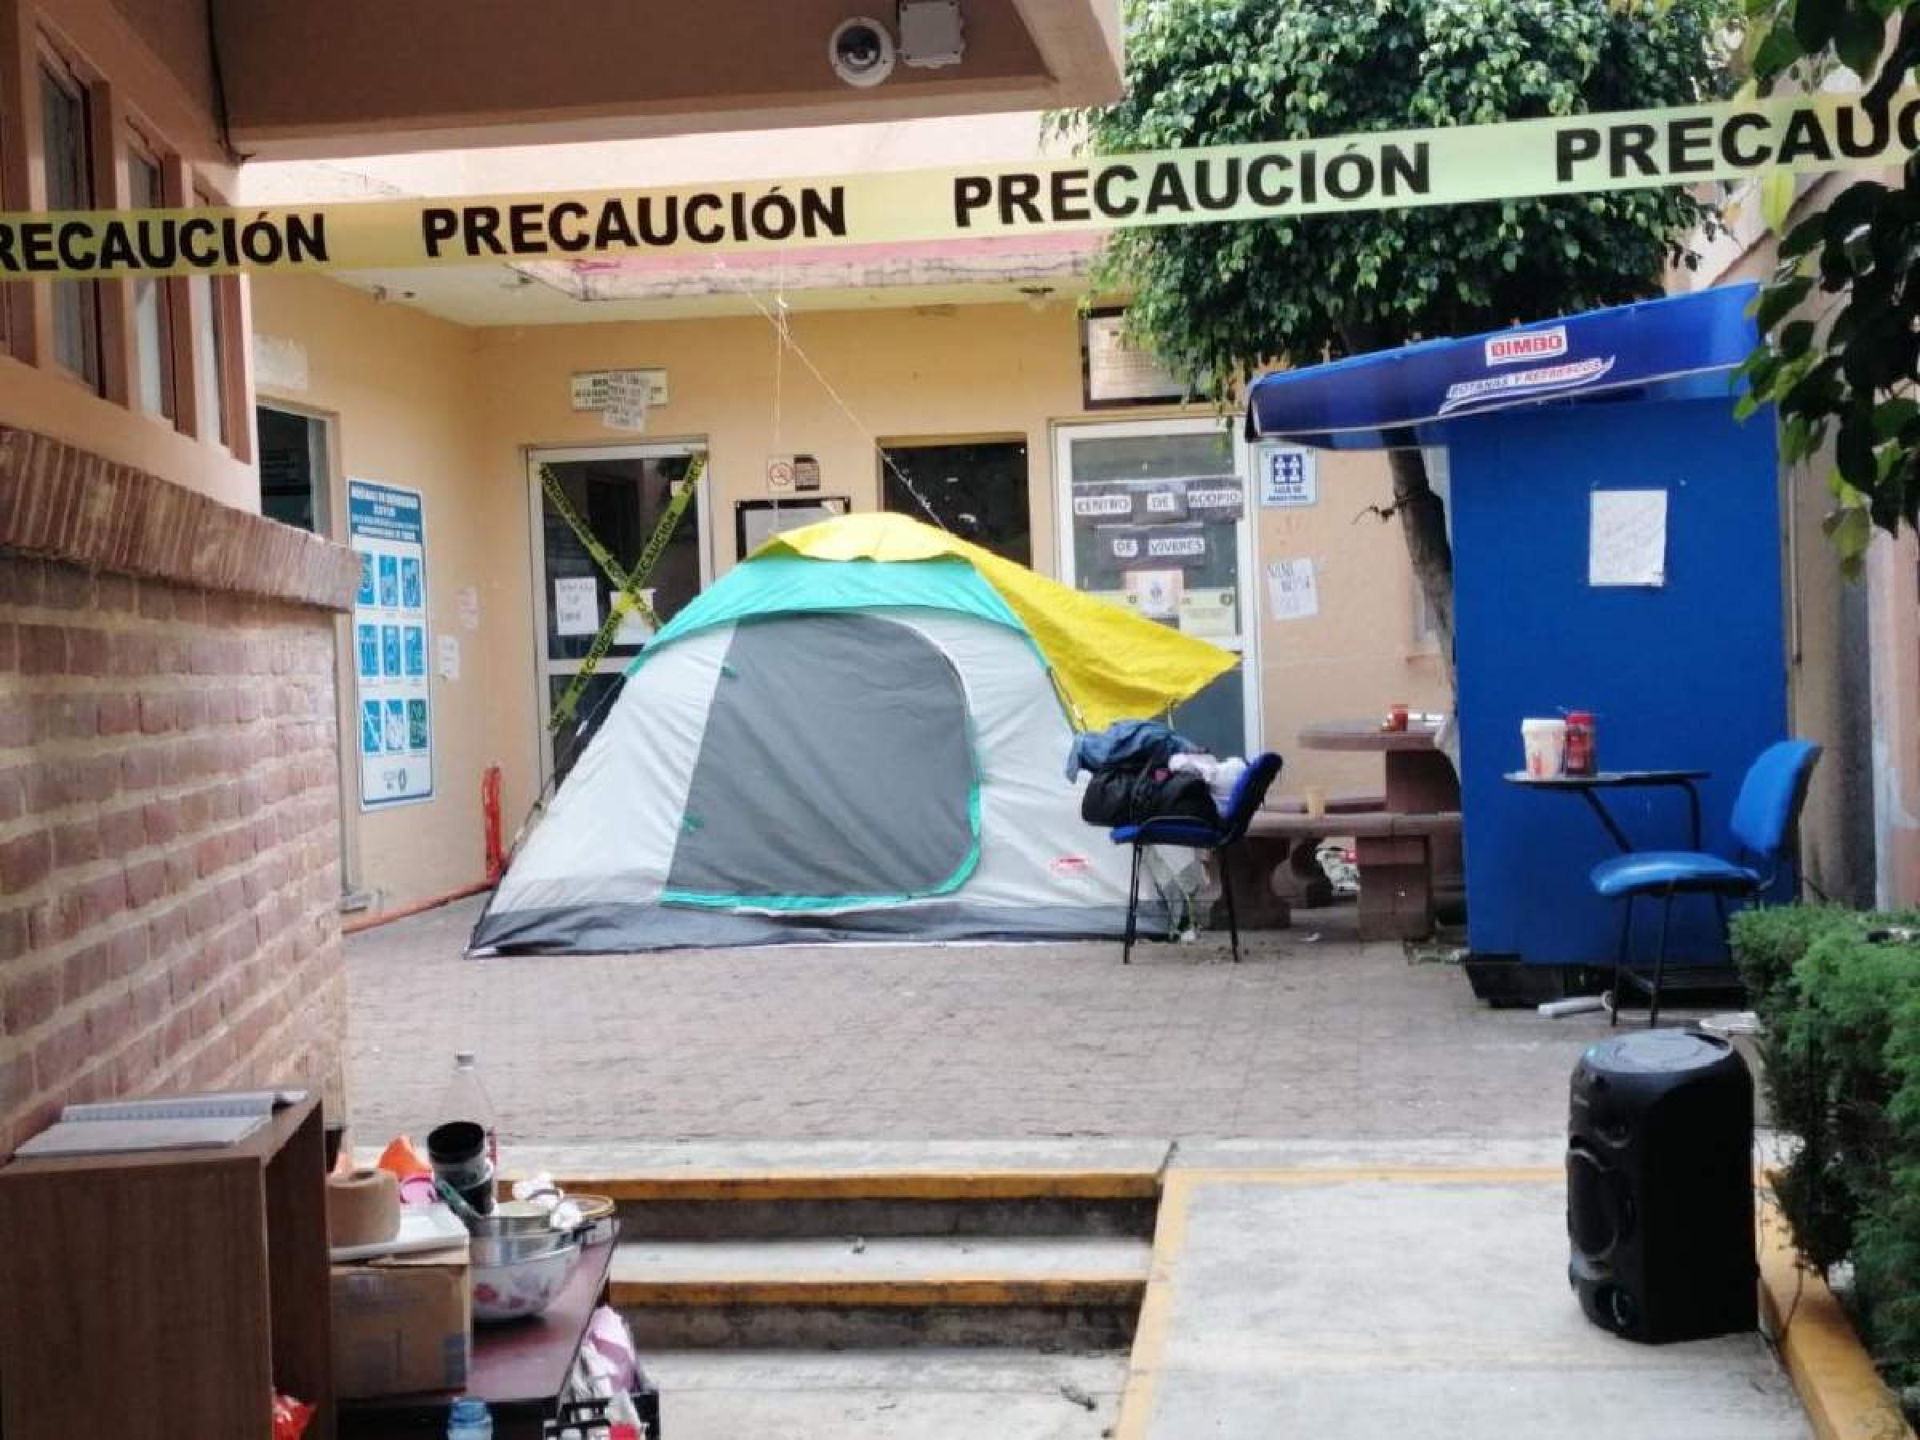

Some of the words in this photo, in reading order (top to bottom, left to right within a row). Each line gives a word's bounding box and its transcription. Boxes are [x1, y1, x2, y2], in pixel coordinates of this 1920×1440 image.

[954, 142, 1430, 228] PRECAUCIÓN
[423, 187, 847, 257] PRECAUCIÓN
[1491, 336, 1562, 357] BIMBO
[1077, 499, 1129, 512] CENTRO
[1151, 497, 1170, 508] DE
[1116, 541, 1136, 553] DE
